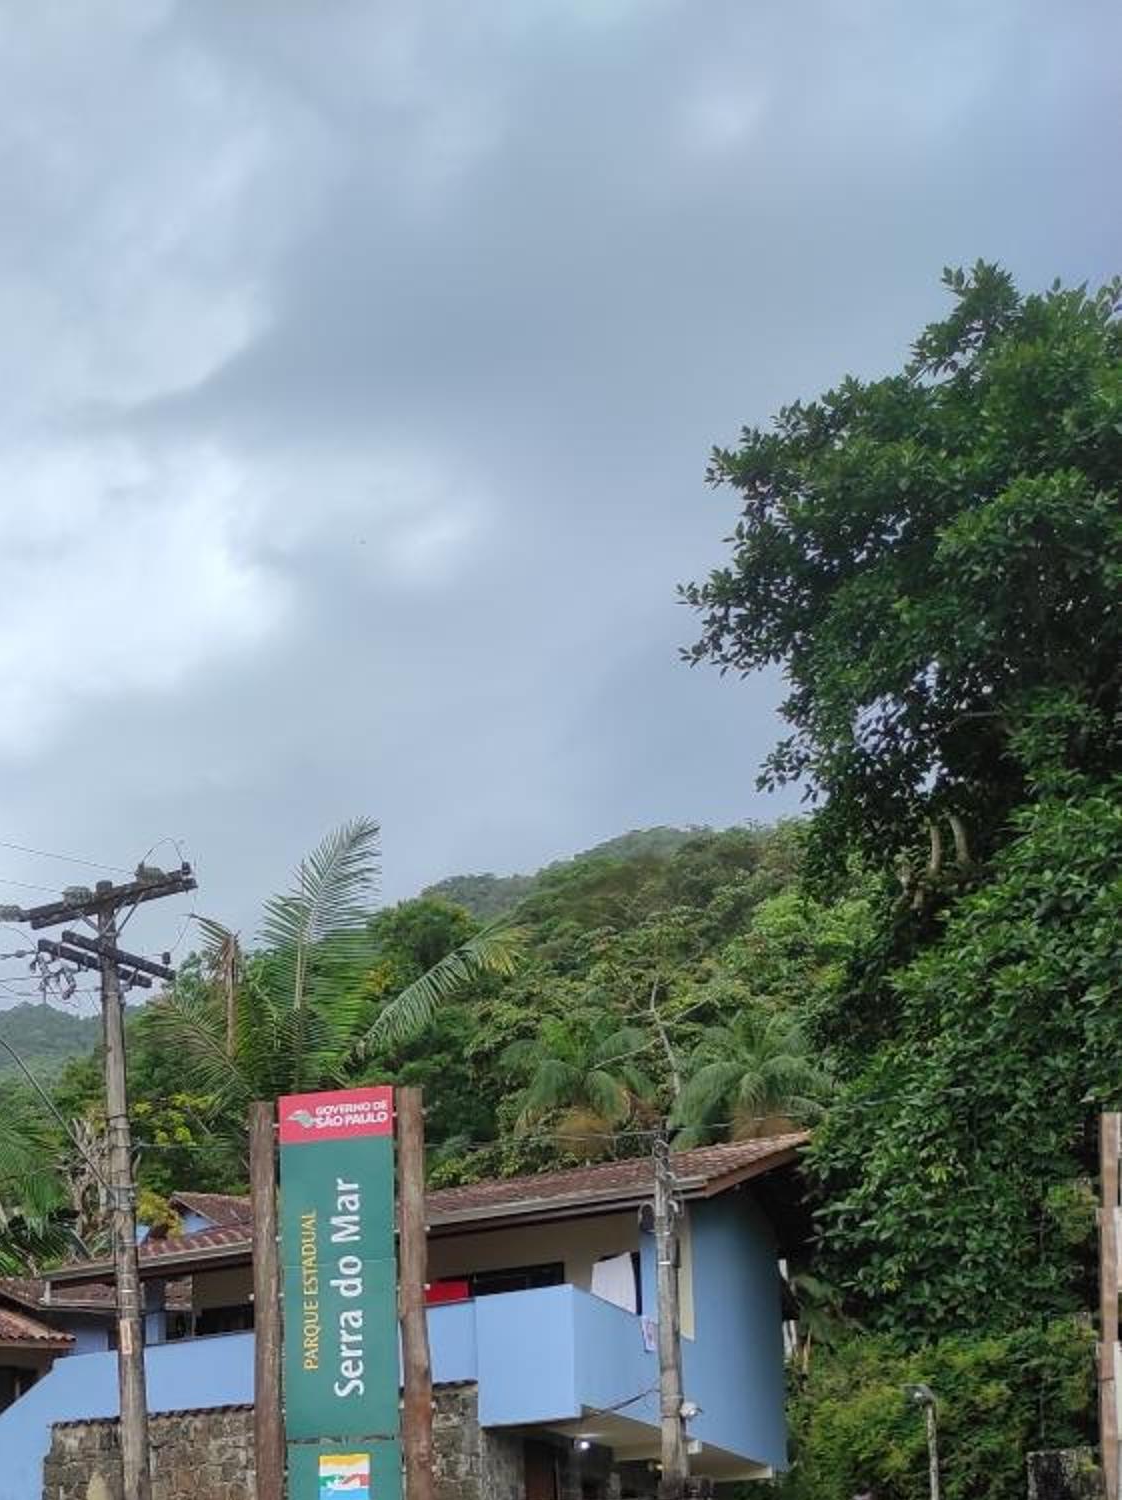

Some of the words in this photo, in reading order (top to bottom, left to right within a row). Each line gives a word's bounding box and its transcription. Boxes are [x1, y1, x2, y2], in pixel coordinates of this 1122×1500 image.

[315, 1101, 370, 1116] GOVERNO
[373, 1099, 388, 1111] DE
[316, 1114, 343, 1129] SÃO
[345, 1111, 388, 1127] PAULO
[331, 1178, 361, 1242] Mar
[301, 1209, 319, 1295] ESTADUAL
[330, 1254, 363, 1298] do
[302, 1300, 320, 1370] PARQUE
[332, 1308, 365, 1398] Serra
